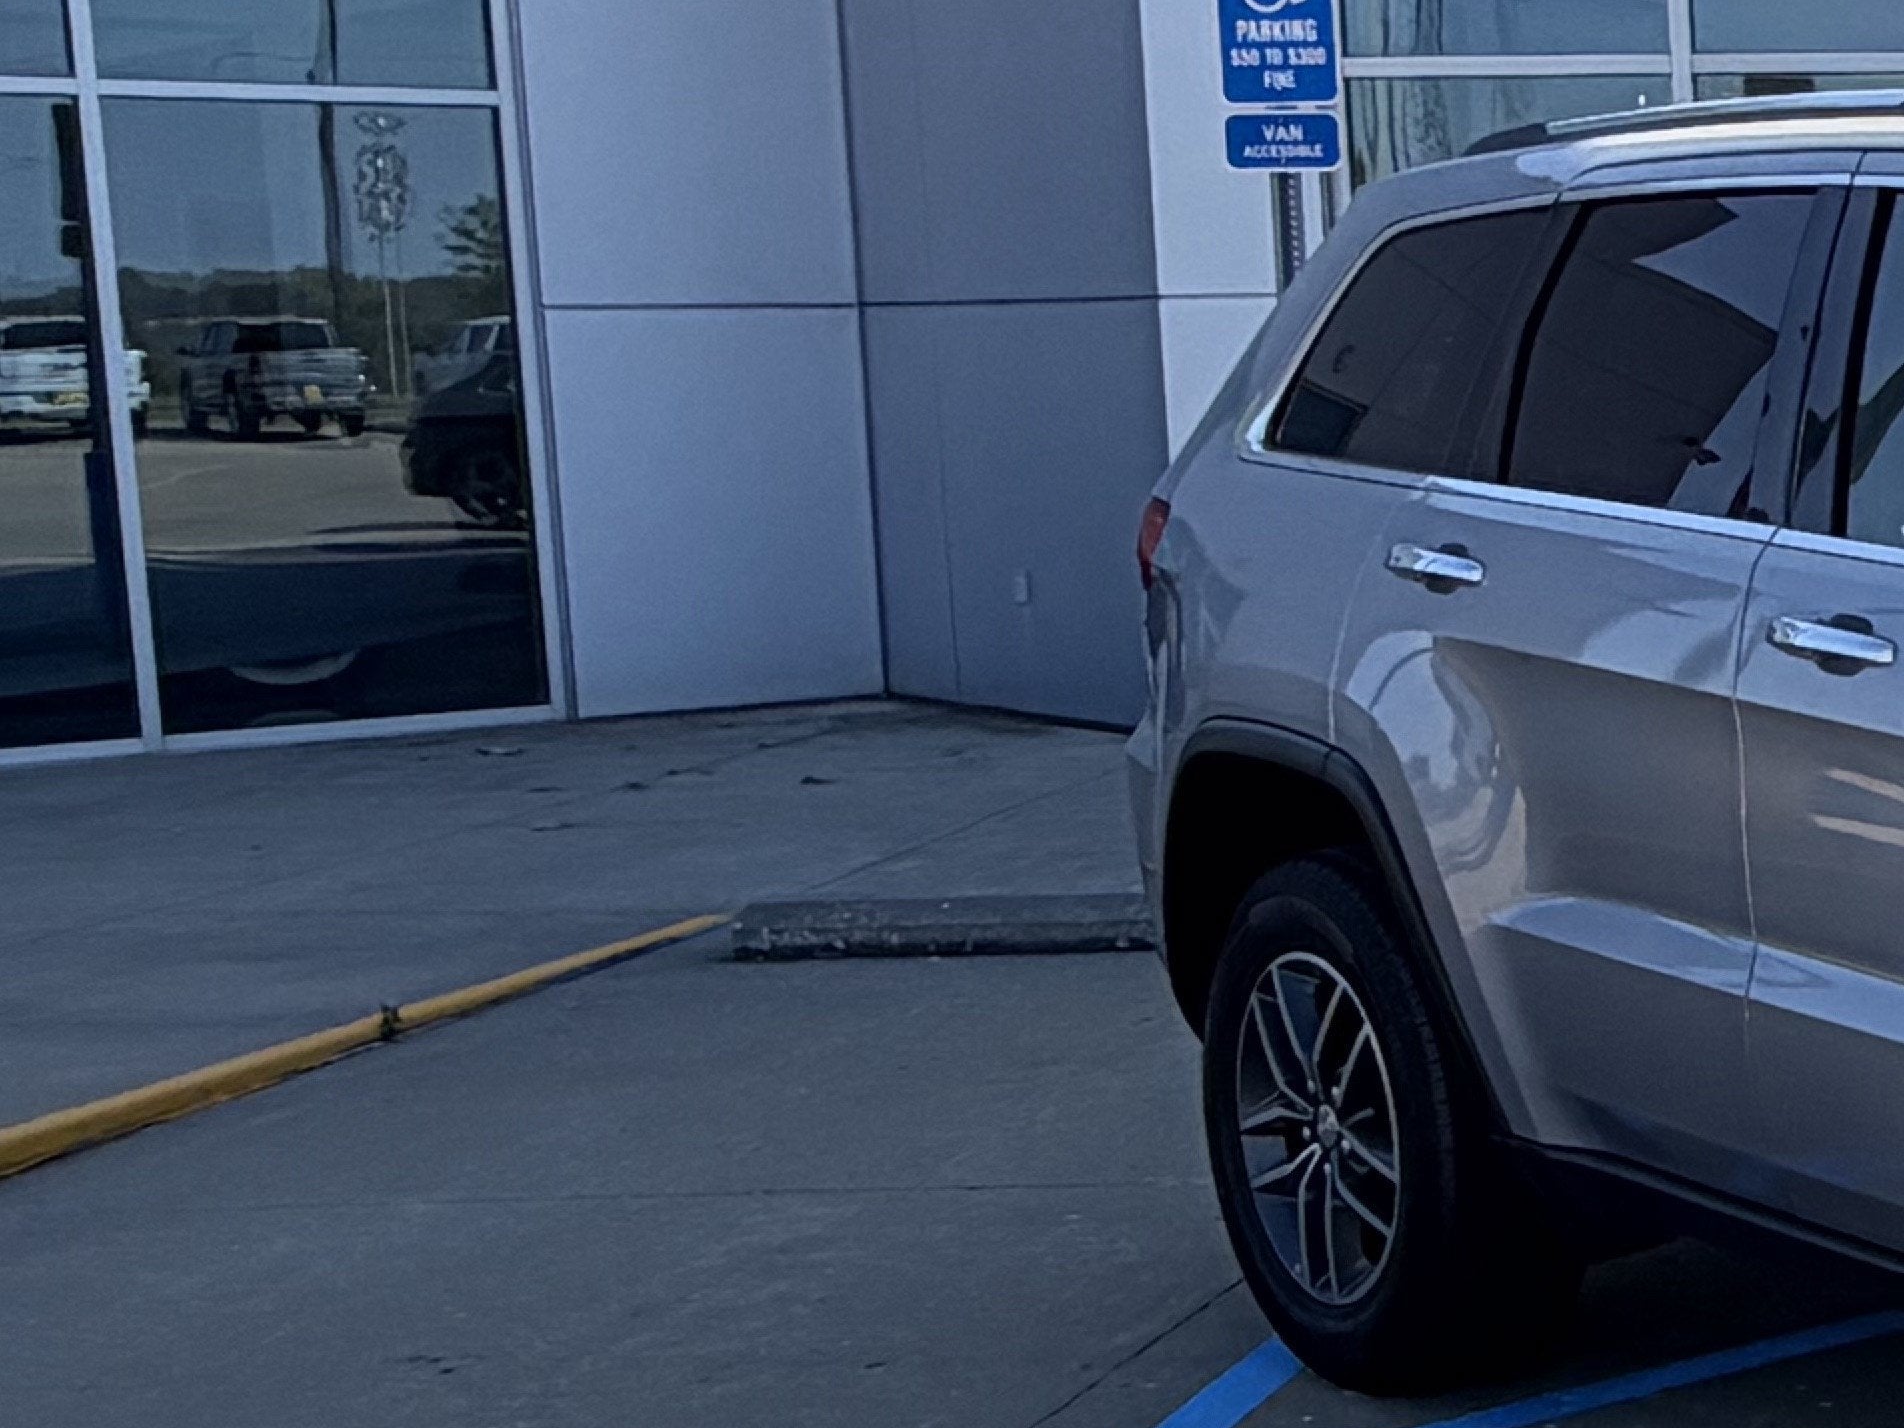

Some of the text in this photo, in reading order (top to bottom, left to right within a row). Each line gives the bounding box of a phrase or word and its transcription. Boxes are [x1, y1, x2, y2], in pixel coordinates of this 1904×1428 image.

[1236, 19, 1318, 43] PARKING
[1265, 47, 1283, 65] TO
[1262, 124, 1304, 142] VAN
[1243, 144, 1324, 158] ACCESSIBLE
